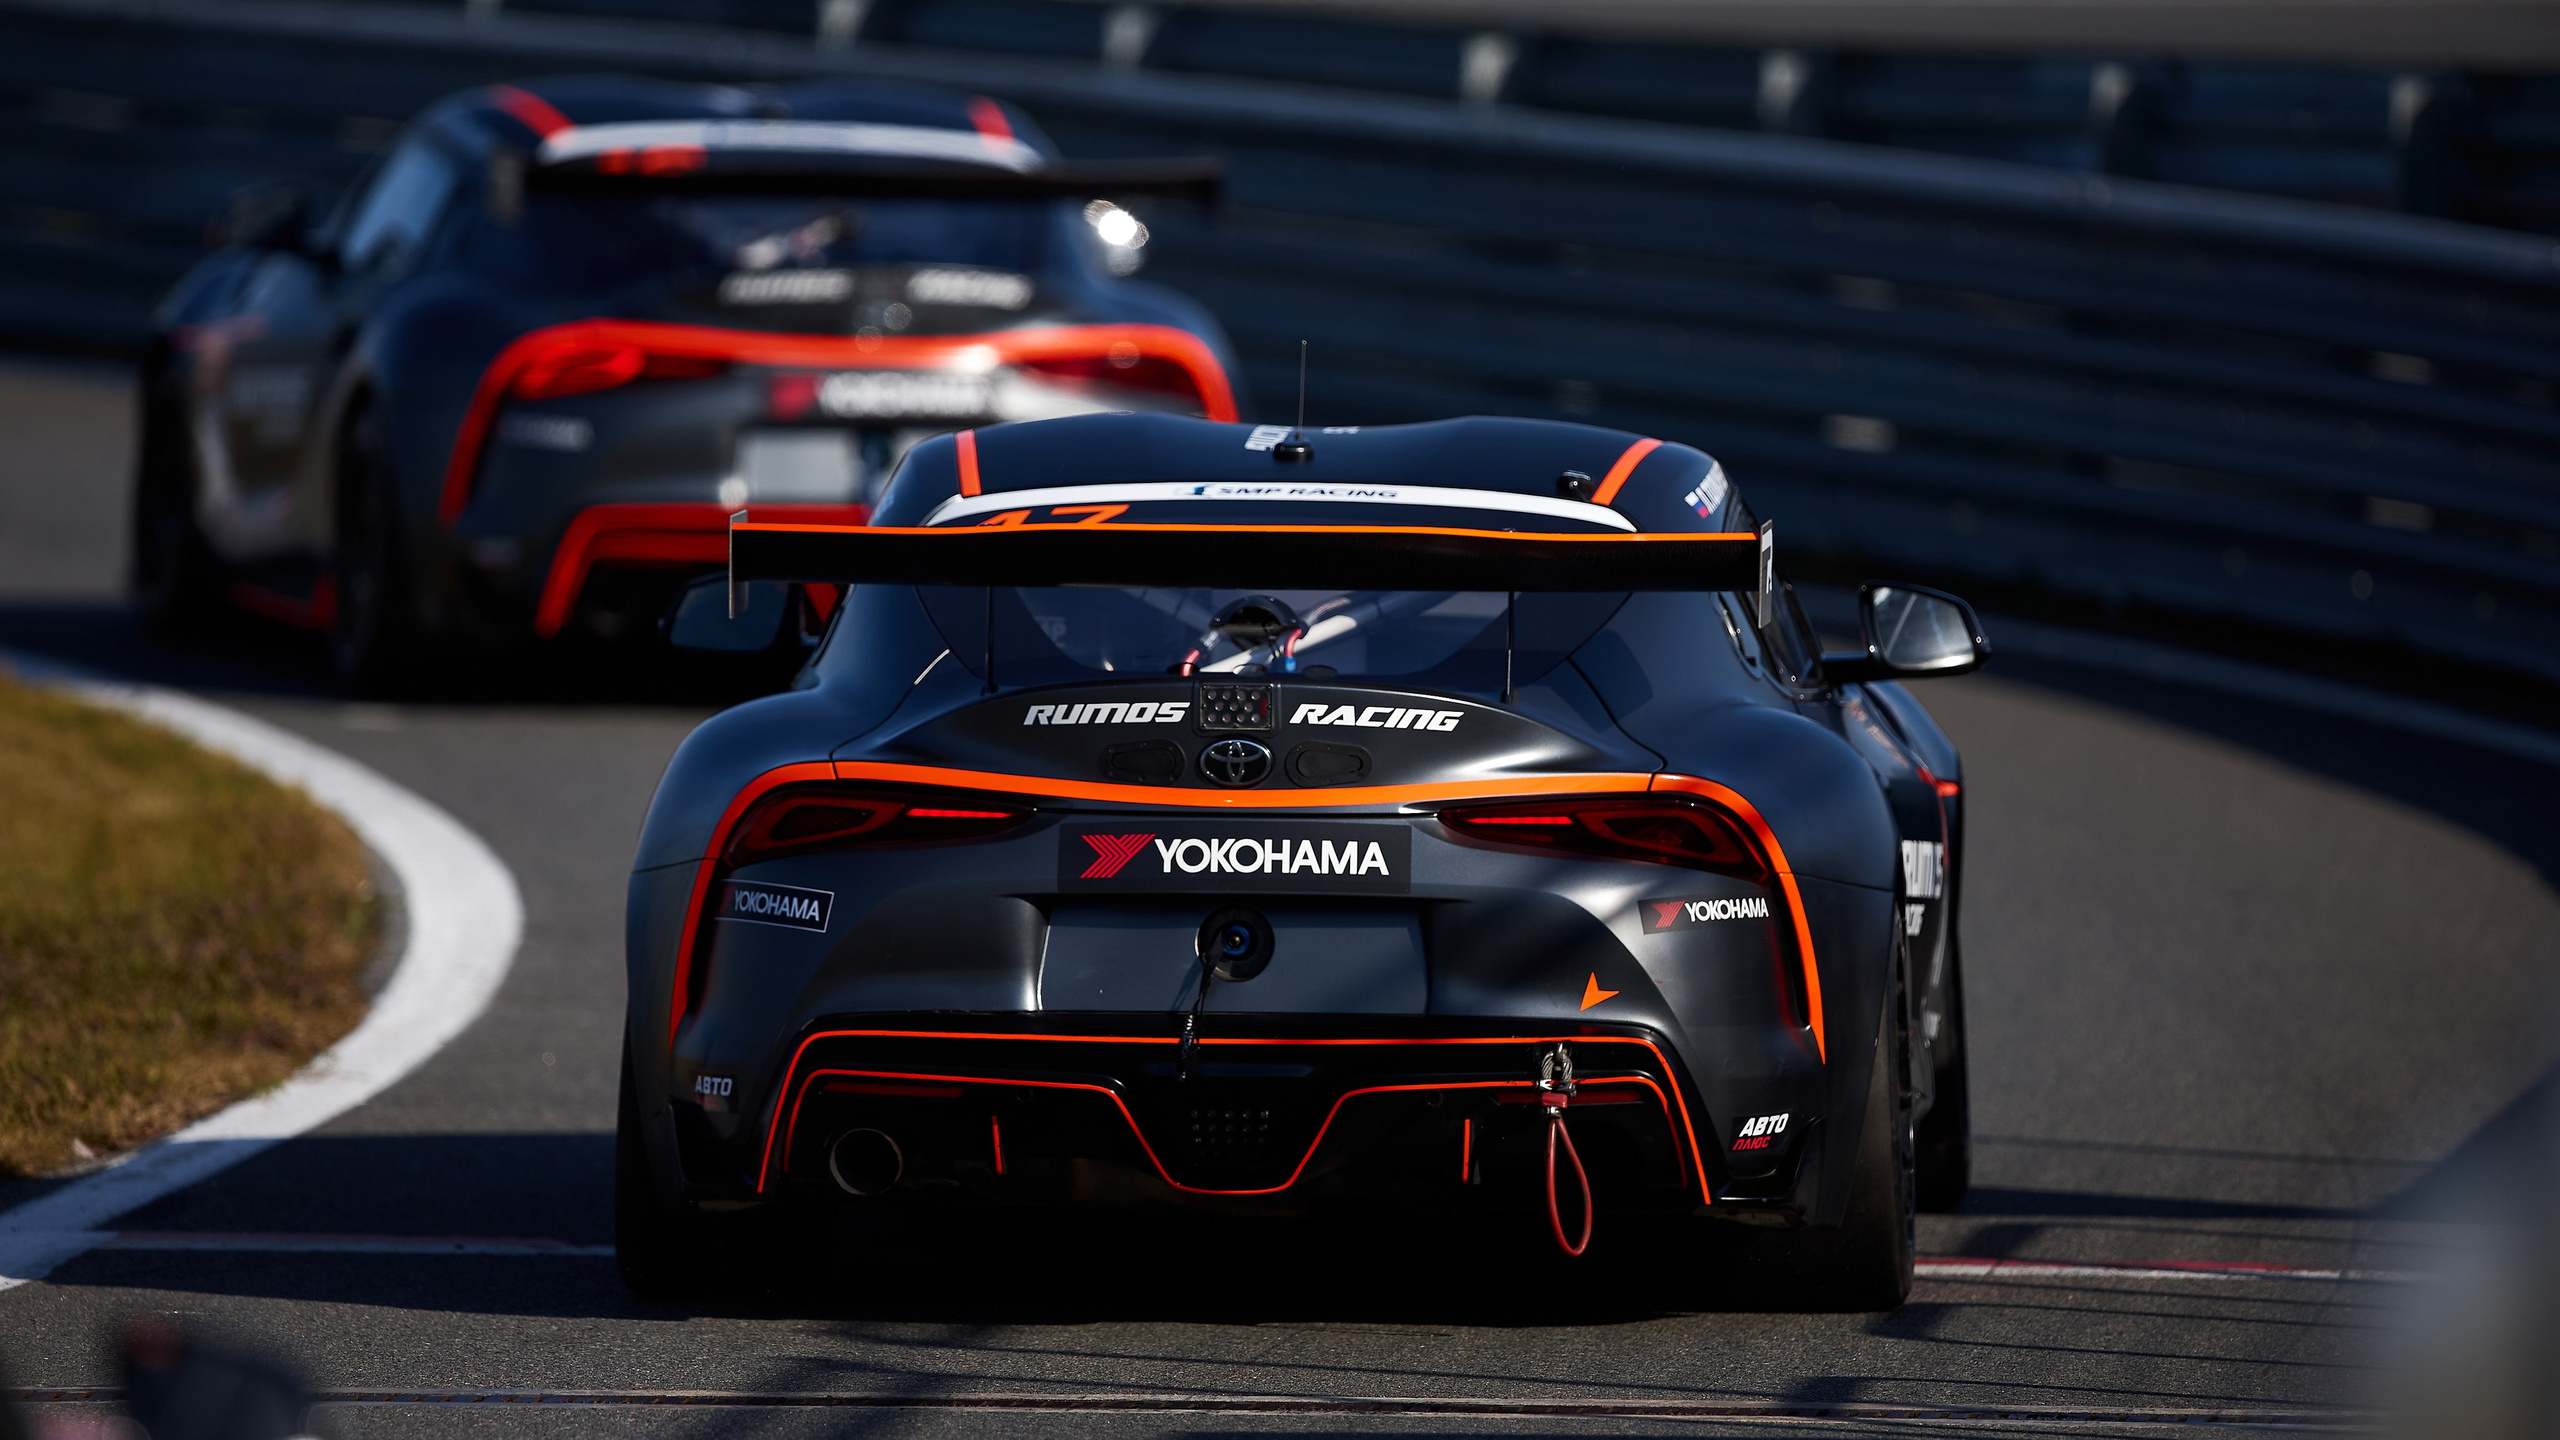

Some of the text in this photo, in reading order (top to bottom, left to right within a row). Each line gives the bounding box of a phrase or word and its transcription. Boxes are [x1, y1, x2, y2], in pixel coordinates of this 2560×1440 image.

[1219, 487, 1398, 498] SMP RACING
[1023, 701, 1465, 732] RUMOS RACING
[1154, 838, 1390, 876] YOKOHAMA
[734, 890, 820, 922] YOKOHAMA
[1684, 897, 1770, 923] YOKOHAMA
[694, 1074, 733, 1096] АВТО
[1738, 1112, 1790, 1138] АВТО
[1732, 1135, 1772, 1151] ПЛЮС
